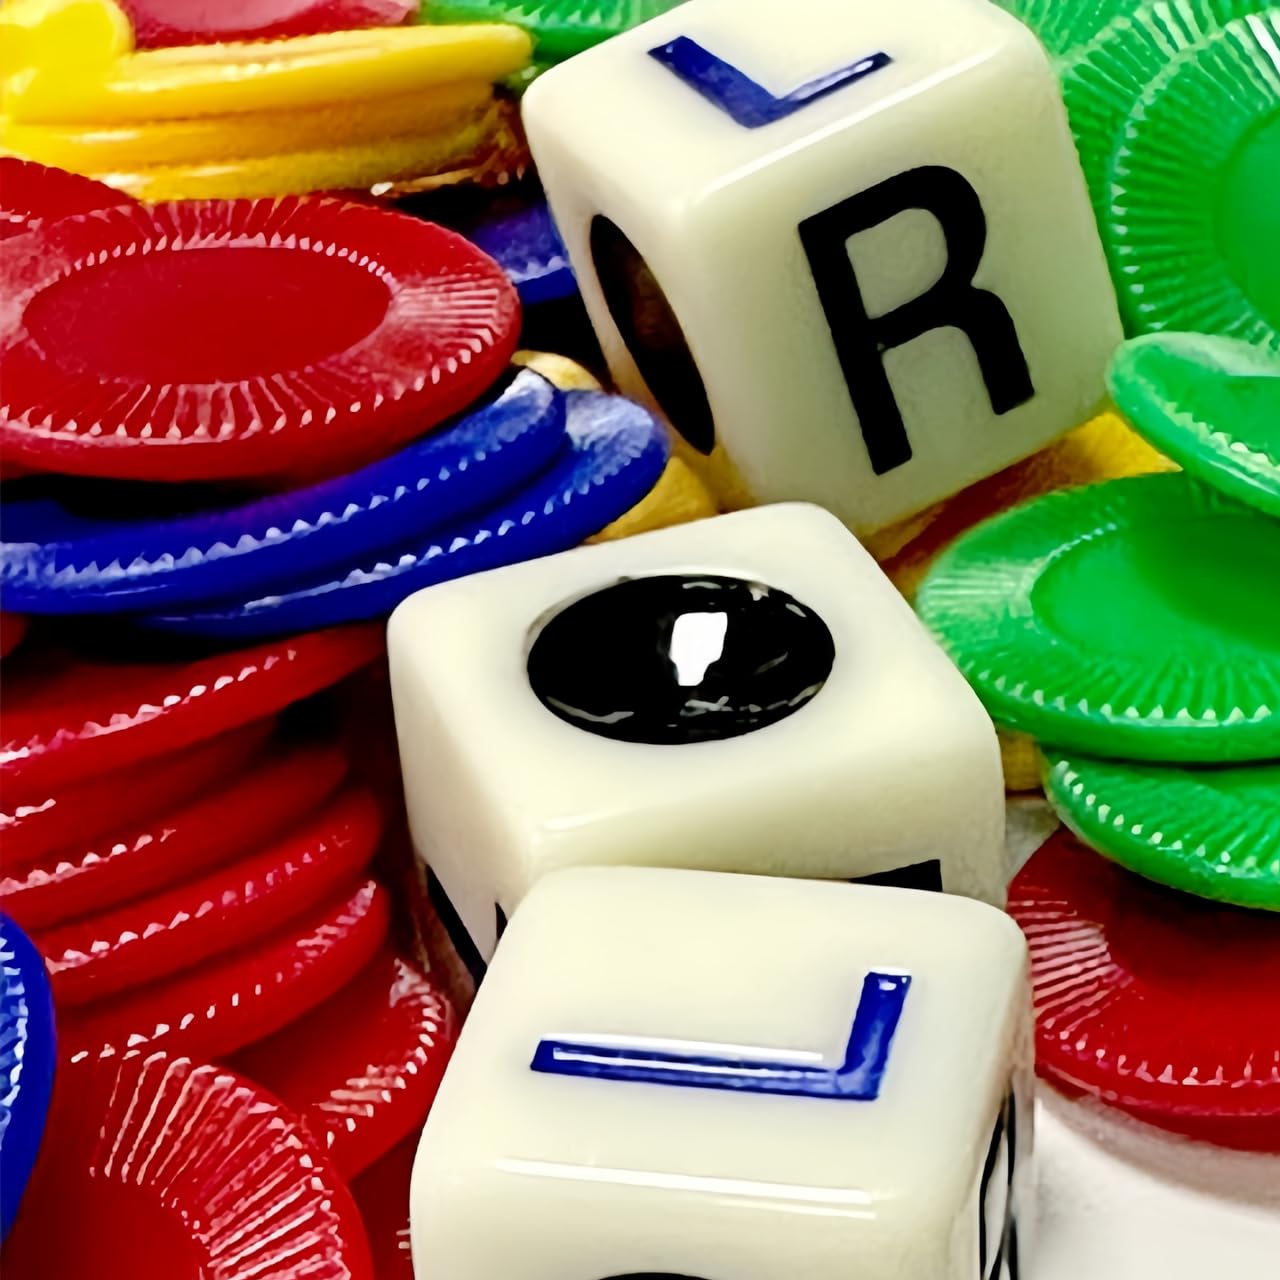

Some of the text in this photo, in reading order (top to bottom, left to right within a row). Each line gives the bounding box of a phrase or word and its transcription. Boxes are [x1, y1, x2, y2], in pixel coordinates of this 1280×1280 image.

[646, 35, 894, 130] L
[797, 164, 1035, 476] R
[530, 969, 912, 1102] L
